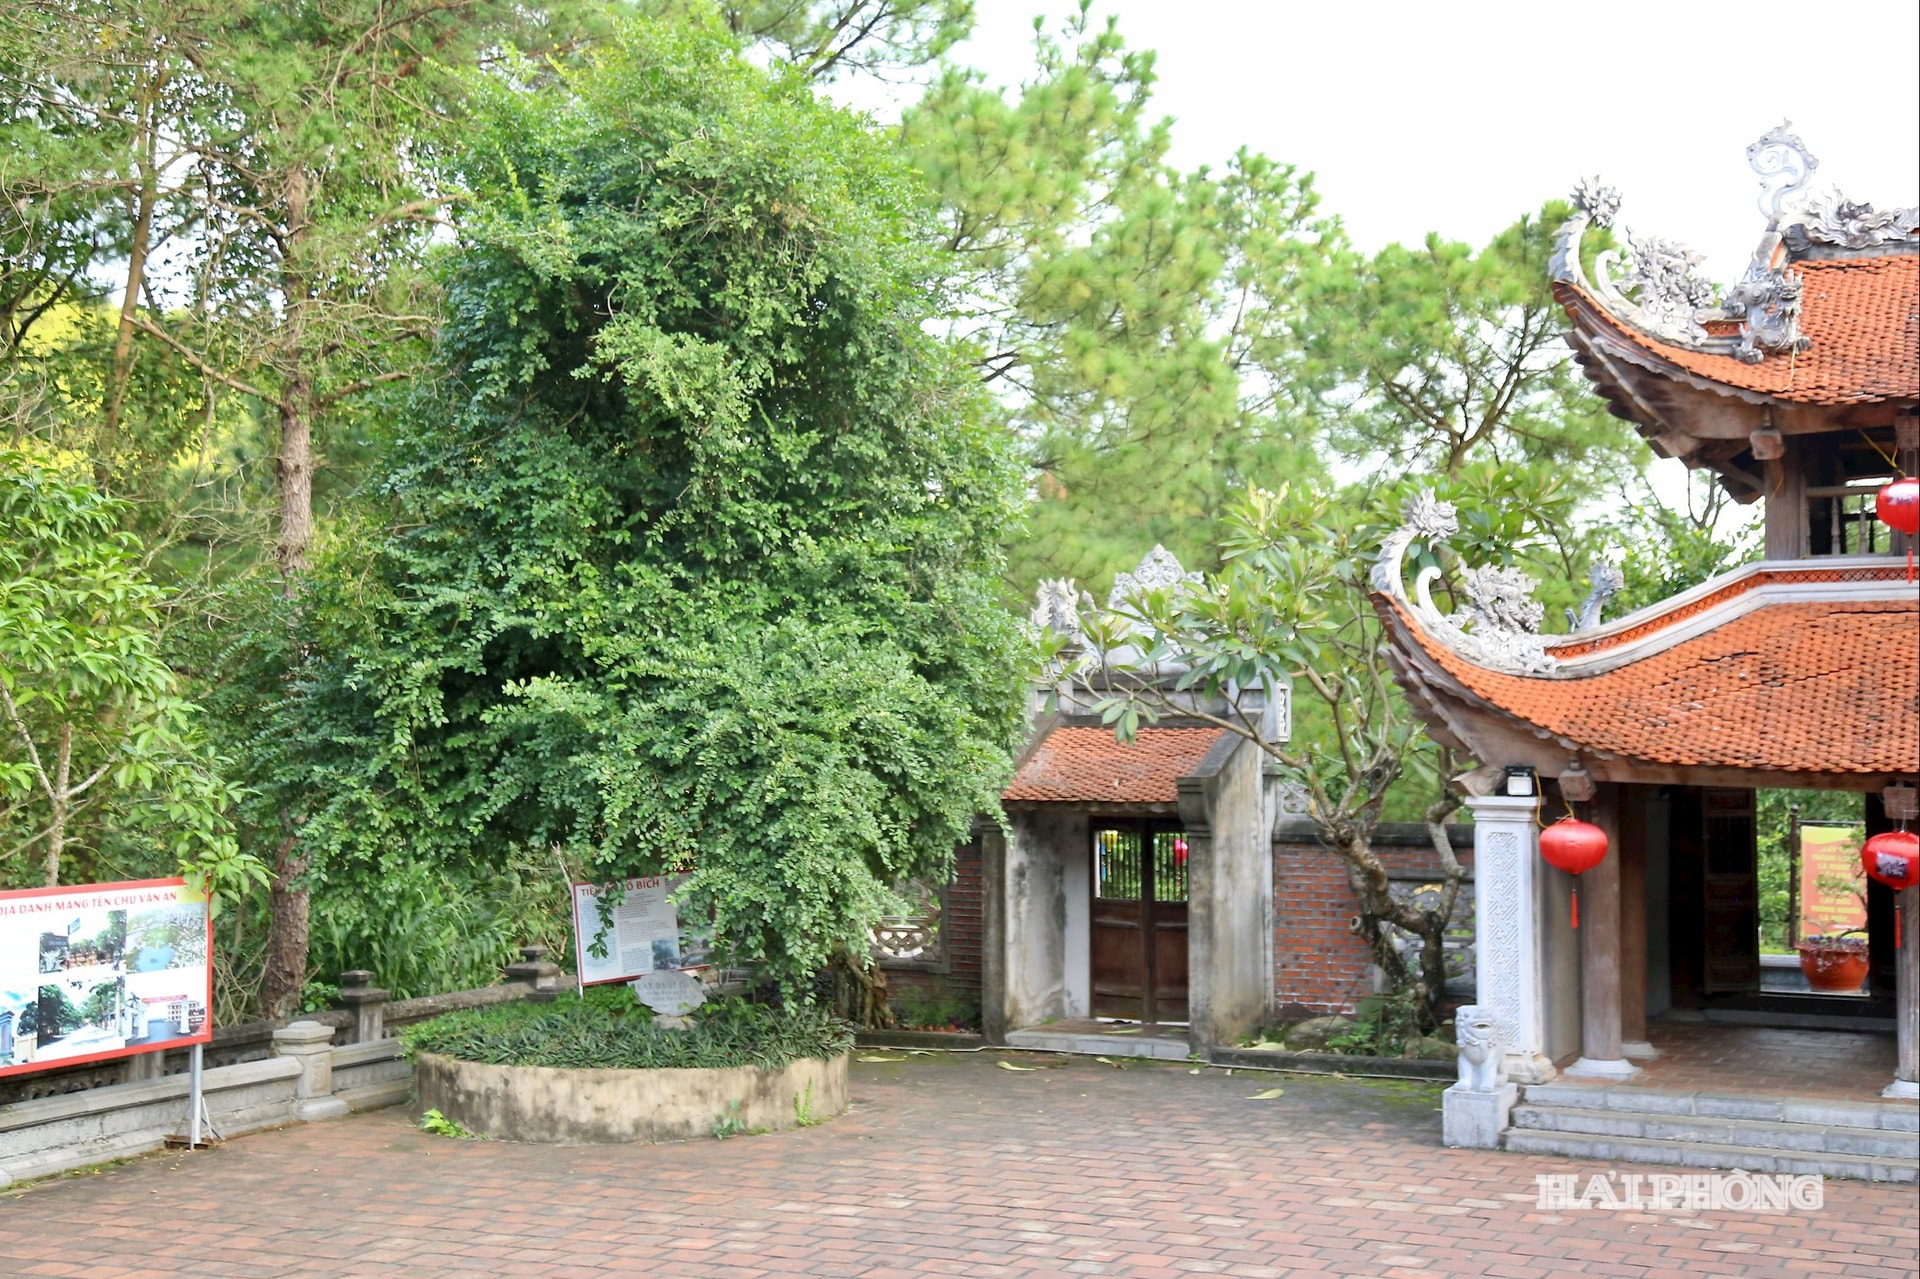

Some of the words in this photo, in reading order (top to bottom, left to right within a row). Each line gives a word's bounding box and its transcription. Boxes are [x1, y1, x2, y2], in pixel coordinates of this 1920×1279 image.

[636, 879, 660, 890] BÍCH
[19, 903, 52, 914] DANH
[55, 899, 89, 910] MANG
[92, 896, 111, 907] TÊN
[113, 895, 136, 906] CHU
[163, 891, 177, 901] AN
